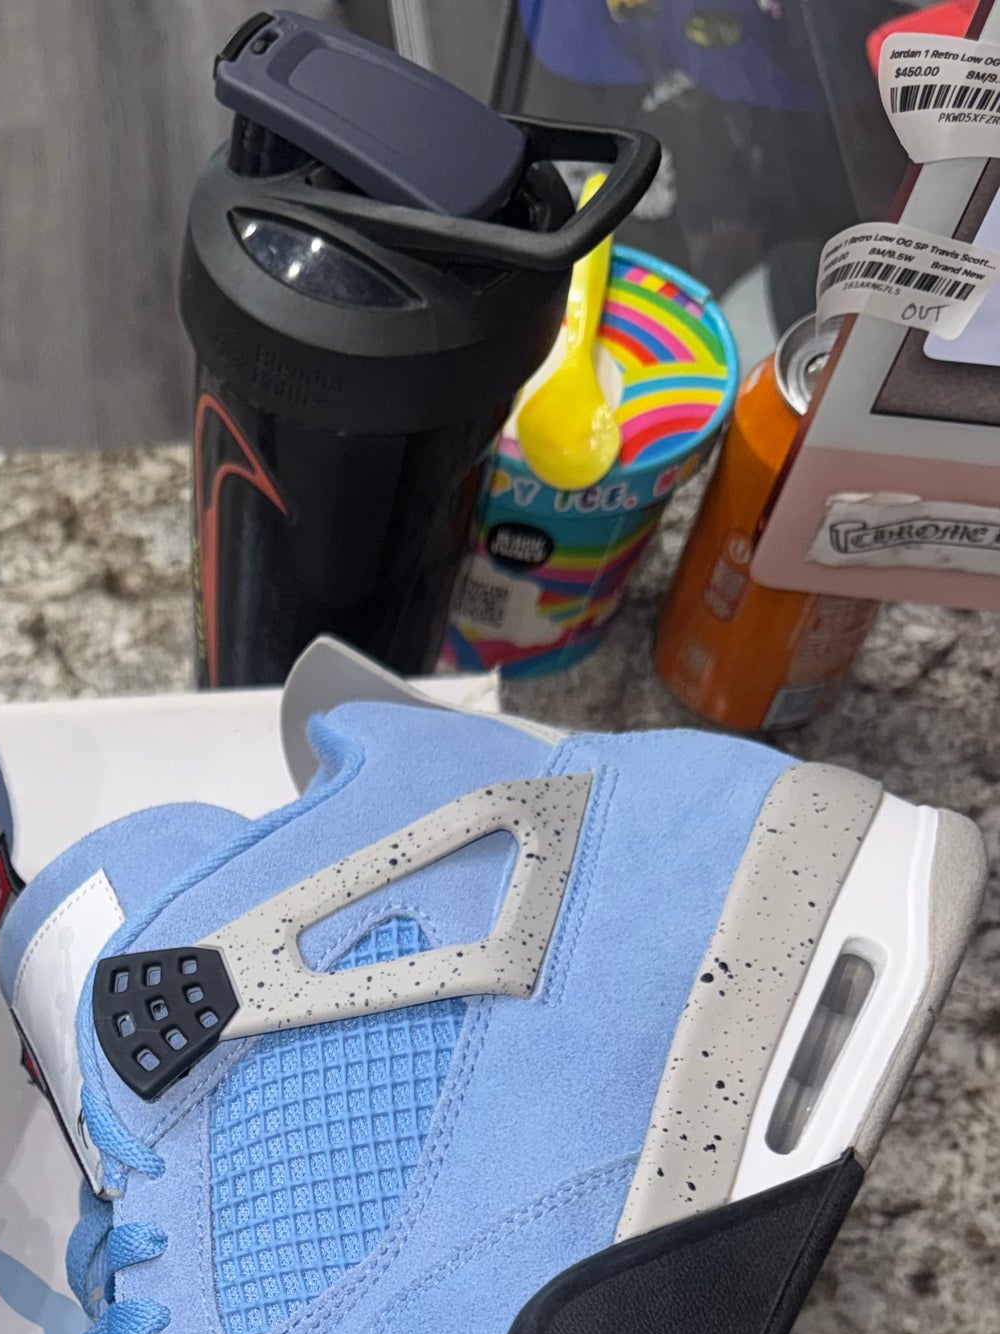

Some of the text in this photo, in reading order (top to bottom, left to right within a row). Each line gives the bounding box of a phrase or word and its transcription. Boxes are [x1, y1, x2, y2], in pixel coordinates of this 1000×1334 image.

[890, 48, 921, 60] Jordan
[924, 49, 930, 59] 1
[931, 50, 960, 61] Retro
[960, 53, 983, 65] Low
[895, 66, 940, 79] $450.00
[874, 233, 896, 243] Low
[896, 237, 914, 248] OG
[913, 242, 929, 251] SP
[930, 245, 960, 259] Travis
[960, 253, 996, 270] Scott...
[868, 247, 986, 280] 8M/9.5W Brand New
[901, 302, 950, 322] OUT
